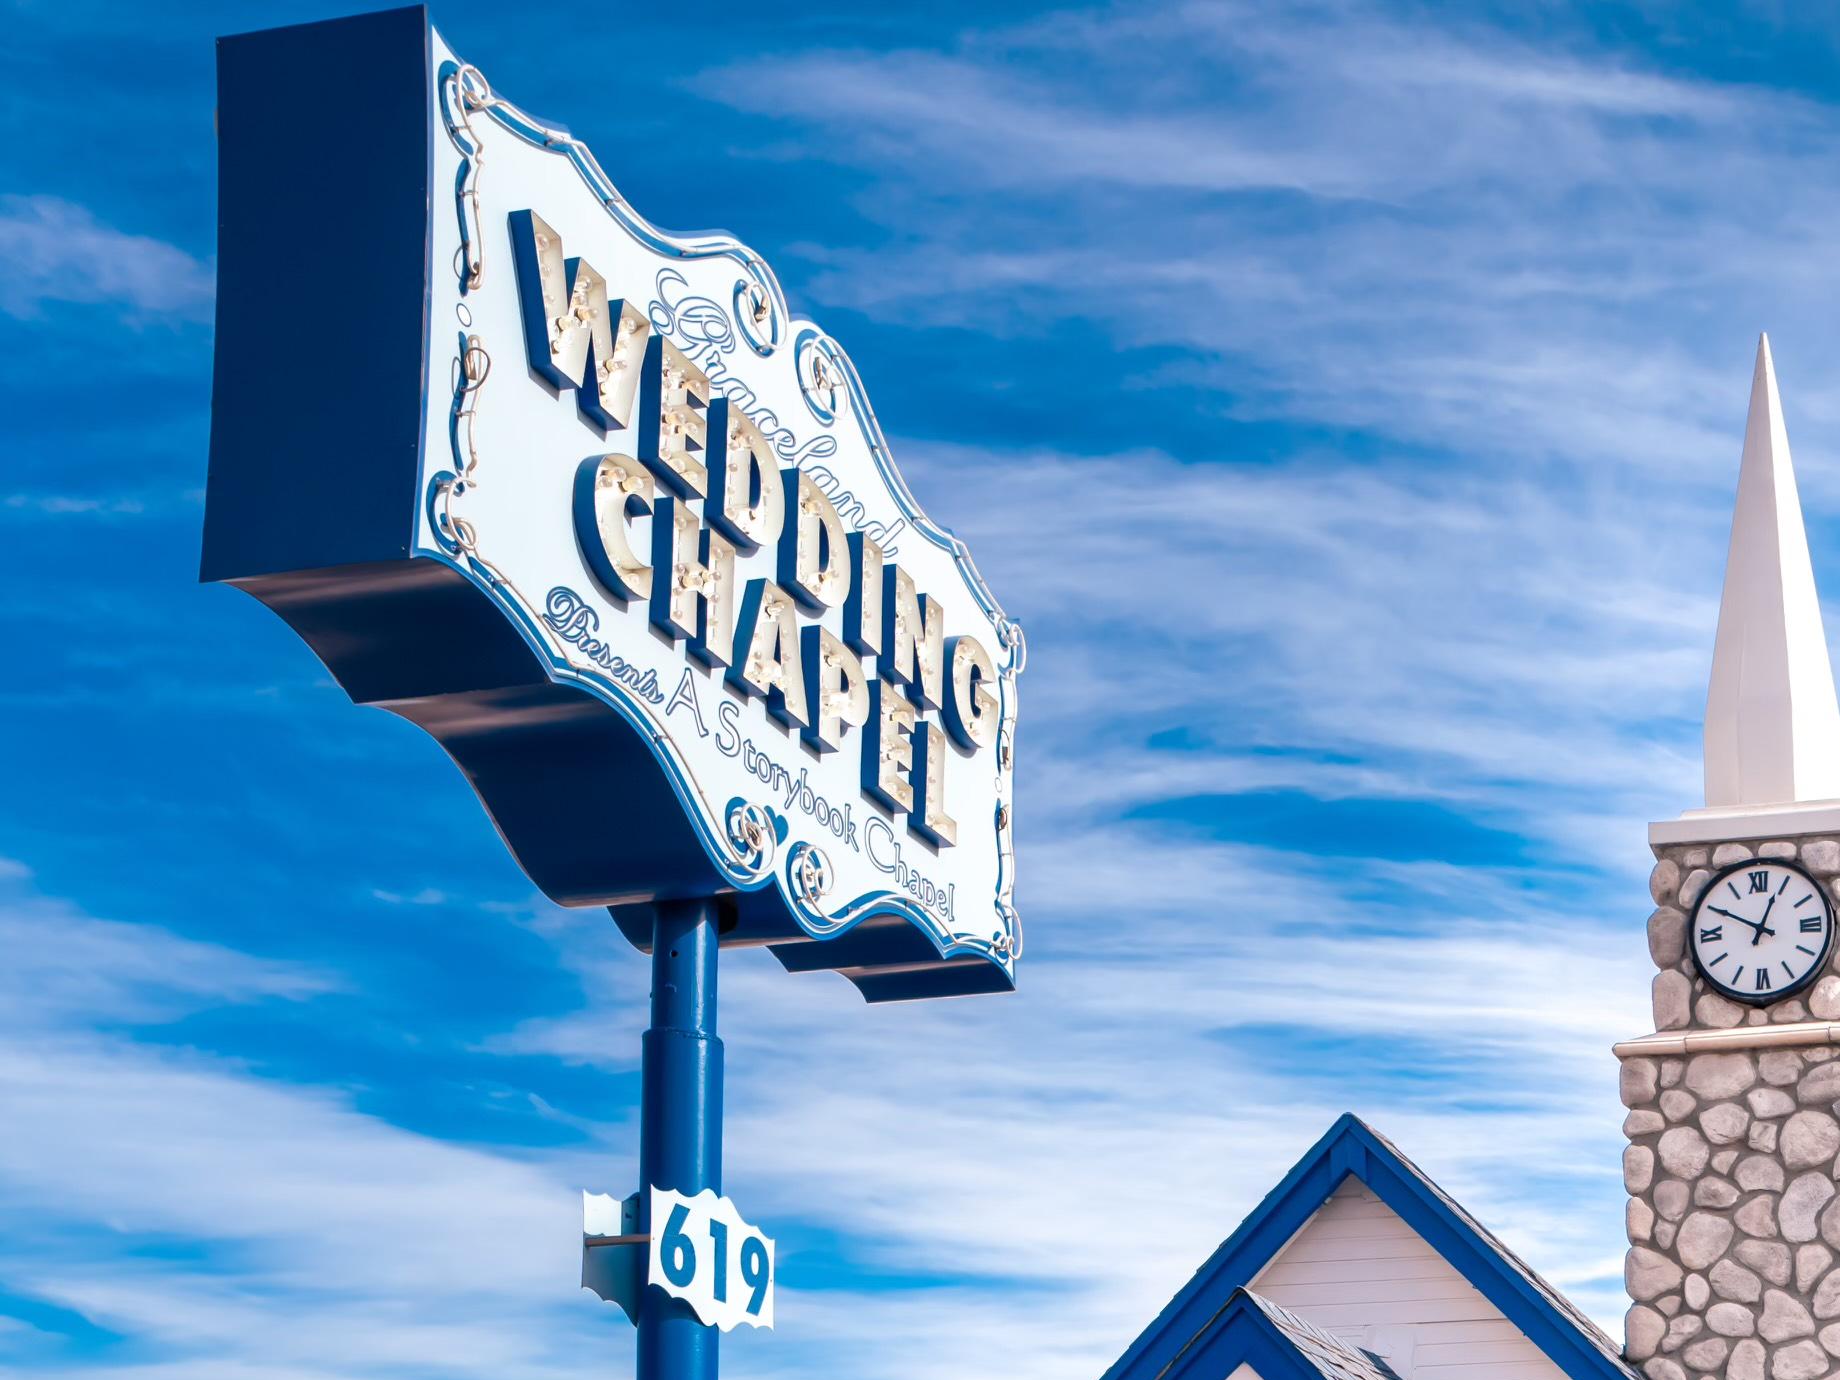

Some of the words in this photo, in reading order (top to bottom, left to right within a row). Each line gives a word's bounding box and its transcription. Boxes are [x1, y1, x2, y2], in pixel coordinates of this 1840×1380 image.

[507, 209, 999, 750] WEDDING
[649, 267, 906, 559] Graceland
[542, 586, 665, 704] Presents
[665, 667, 709, 738] A
[715, 700, 860, 853] Storybook
[864, 816, 956, 922] Chapel
[572, 453, 957, 848] CHAPEL
[660, 1203, 769, 1316] 619
